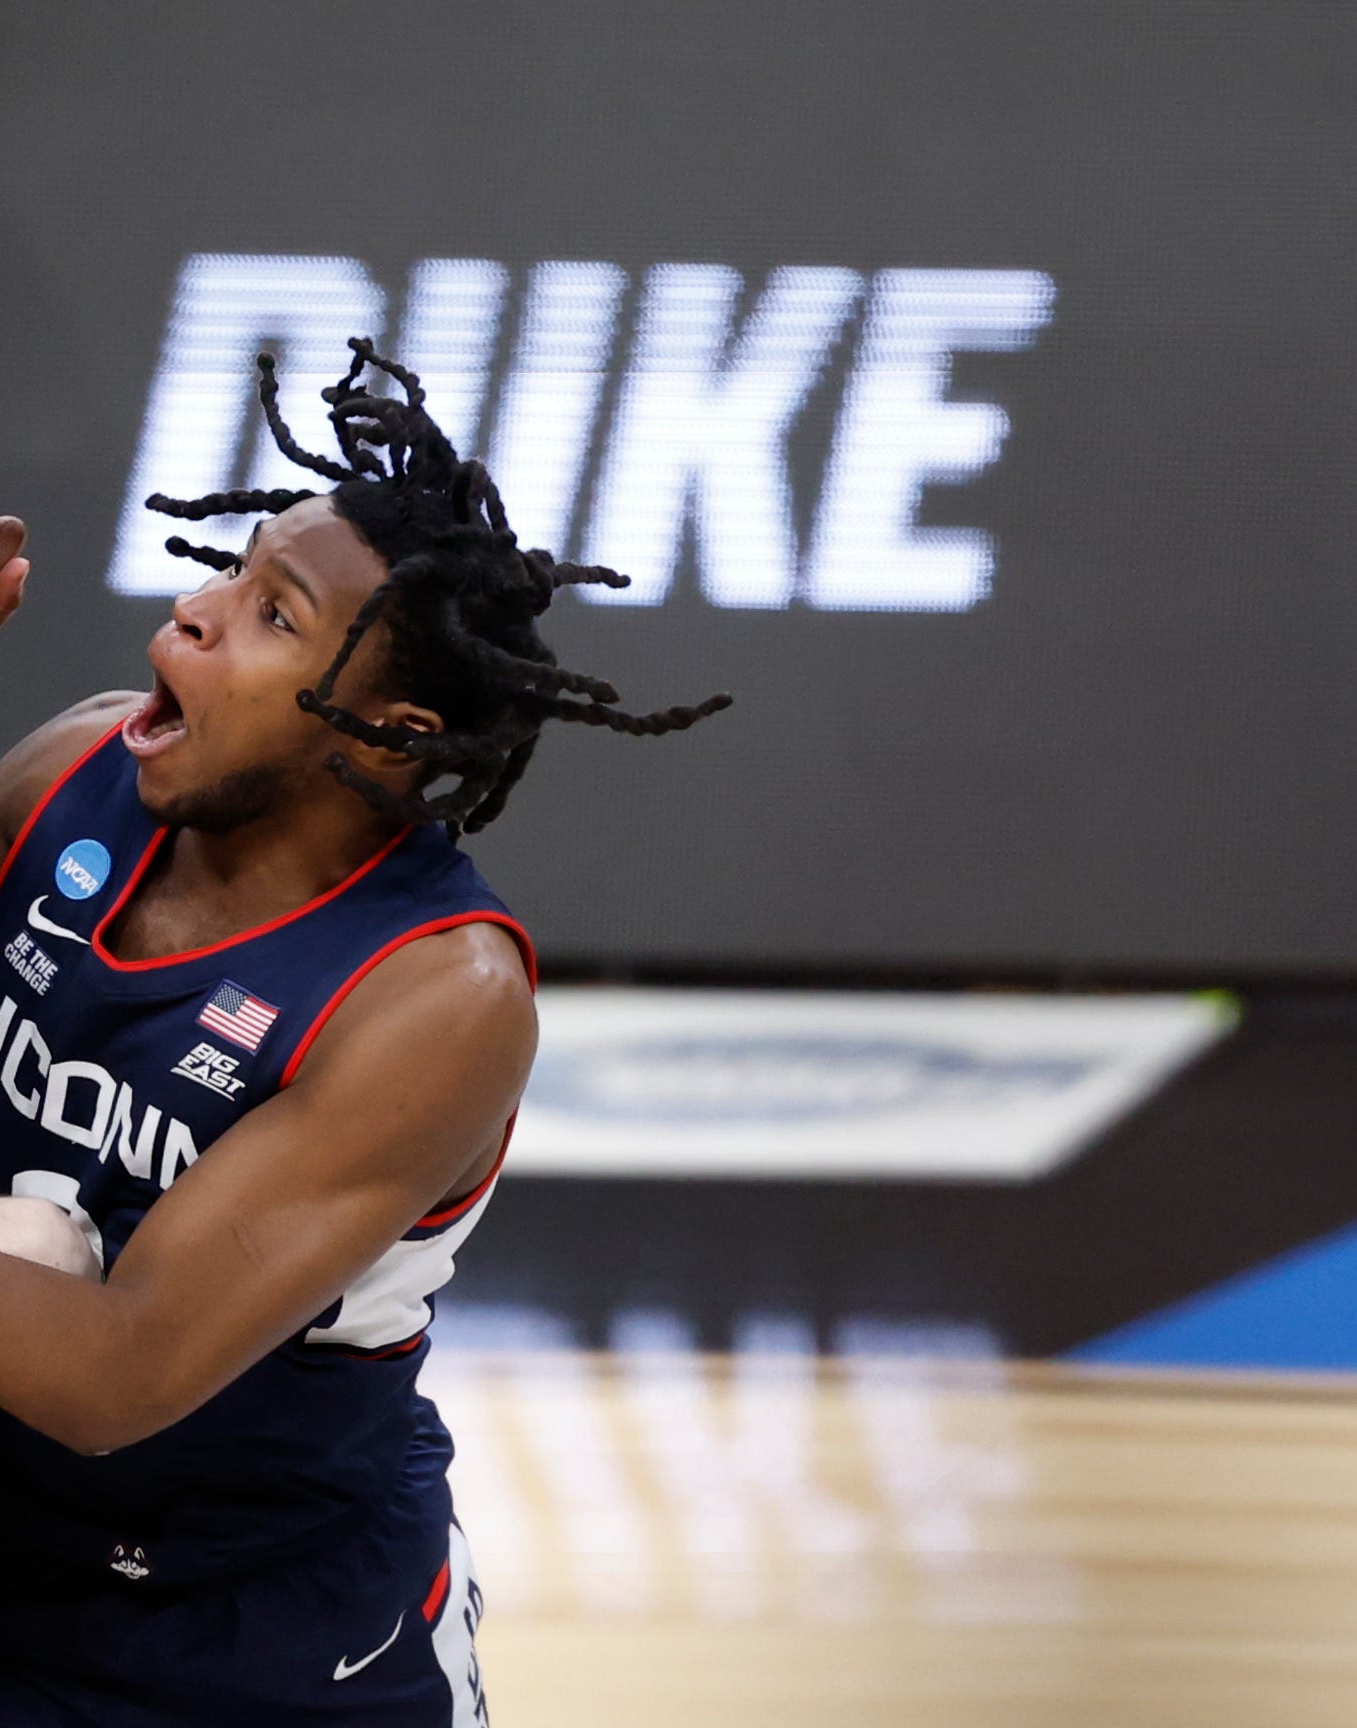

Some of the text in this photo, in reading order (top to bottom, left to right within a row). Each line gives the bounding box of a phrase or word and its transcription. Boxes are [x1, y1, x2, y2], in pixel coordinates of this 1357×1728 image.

[107, 252, 1056, 614] DUKE
[59, 856, 100, 896] NCAA
[3, 943, 51, 997] CHANGE
[12, 932, 59, 981] BE THE
[177, 1053, 247, 1094] EAST
[189, 1041, 241, 1074] BIG
